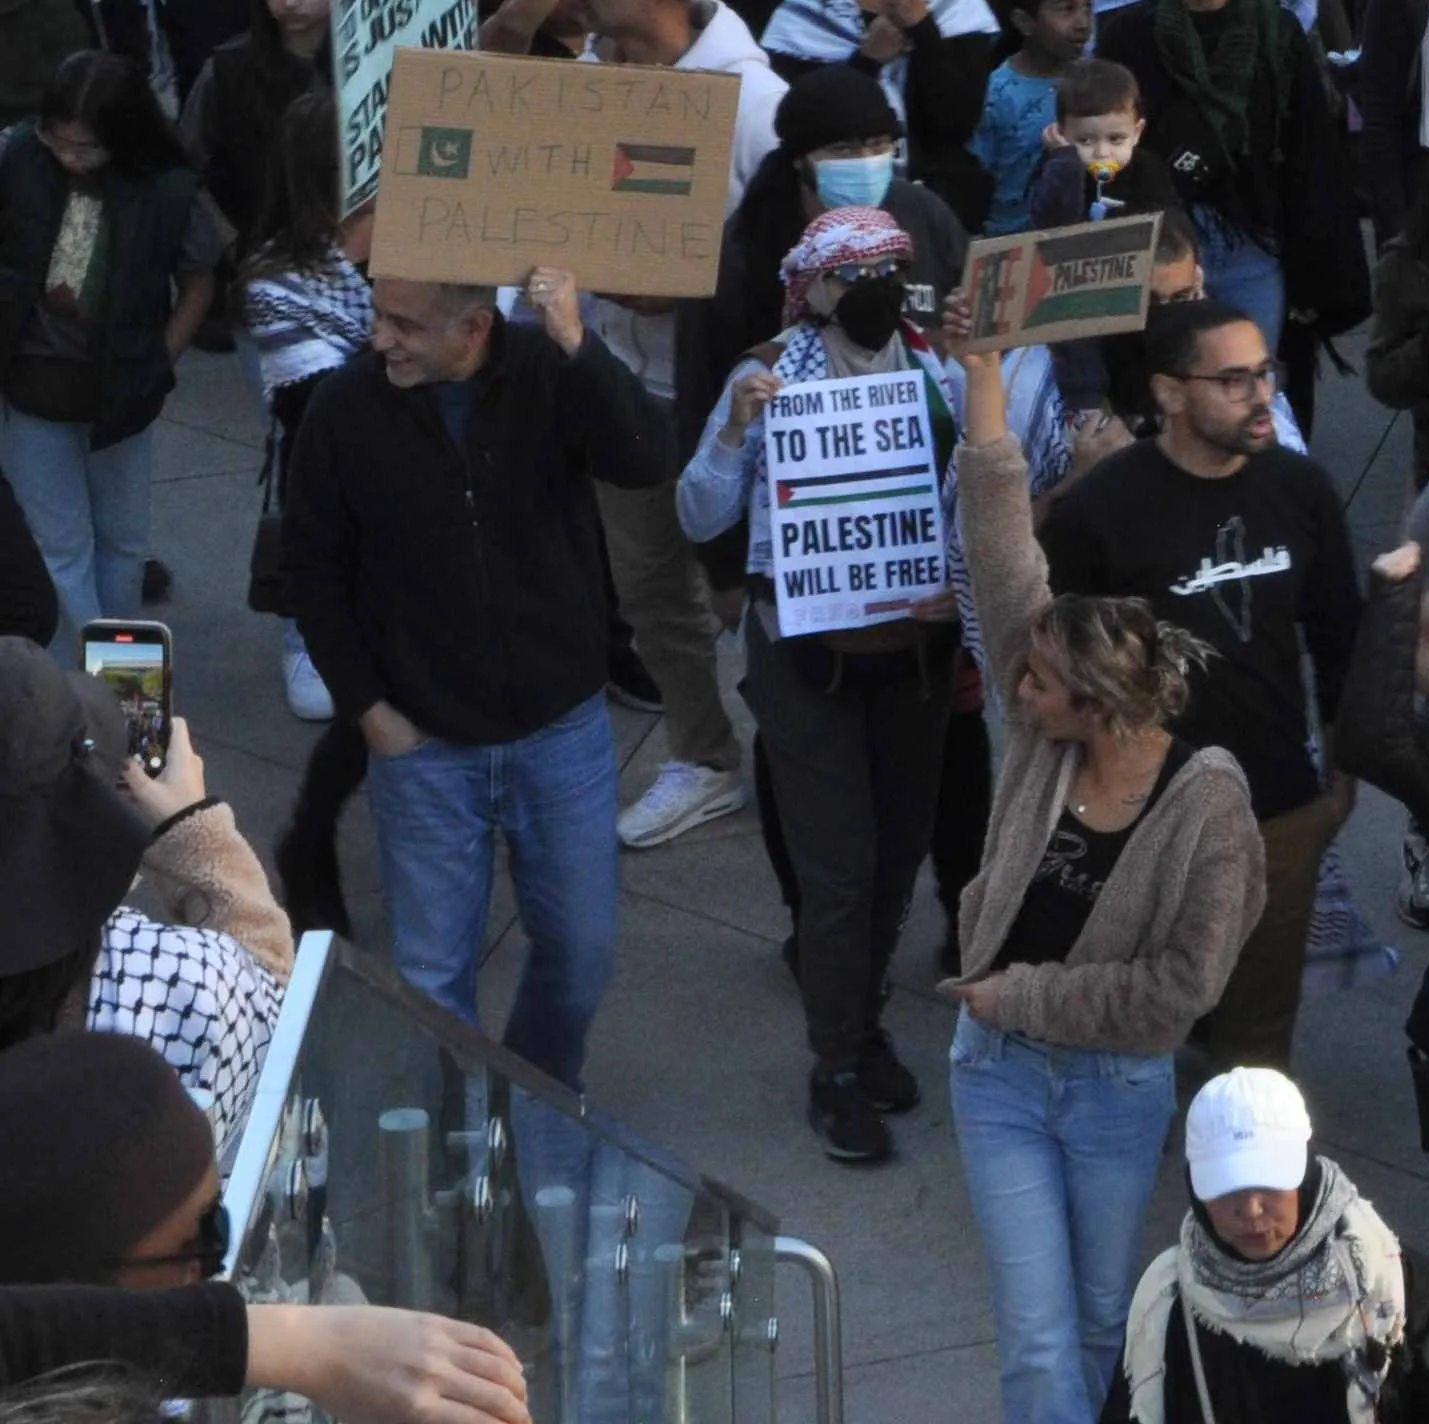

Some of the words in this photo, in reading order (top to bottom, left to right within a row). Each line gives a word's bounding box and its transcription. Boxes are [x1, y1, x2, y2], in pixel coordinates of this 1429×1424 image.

[438, 69, 711, 121] PAKISTAN
[486, 143, 592, 177] WITH
[417, 195, 713, 260] PALESTINE
[1053, 254, 1137, 293] PALESTINE
[770, 390, 824, 419] FROM
[829, 386, 861, 412] THE
[868, 380, 918, 408] RIVER
[772, 429, 806, 464] TO
[815, 422, 867, 459] THE
[873, 415, 925, 451] SEA
[780, 507, 937, 559] PALESTINE
[783, 566, 841, 599] WILL
[848, 562, 877, 592] BE
[885, 556, 940, 589] FREE
[1168, 544, 1291, 596] فلسطين
